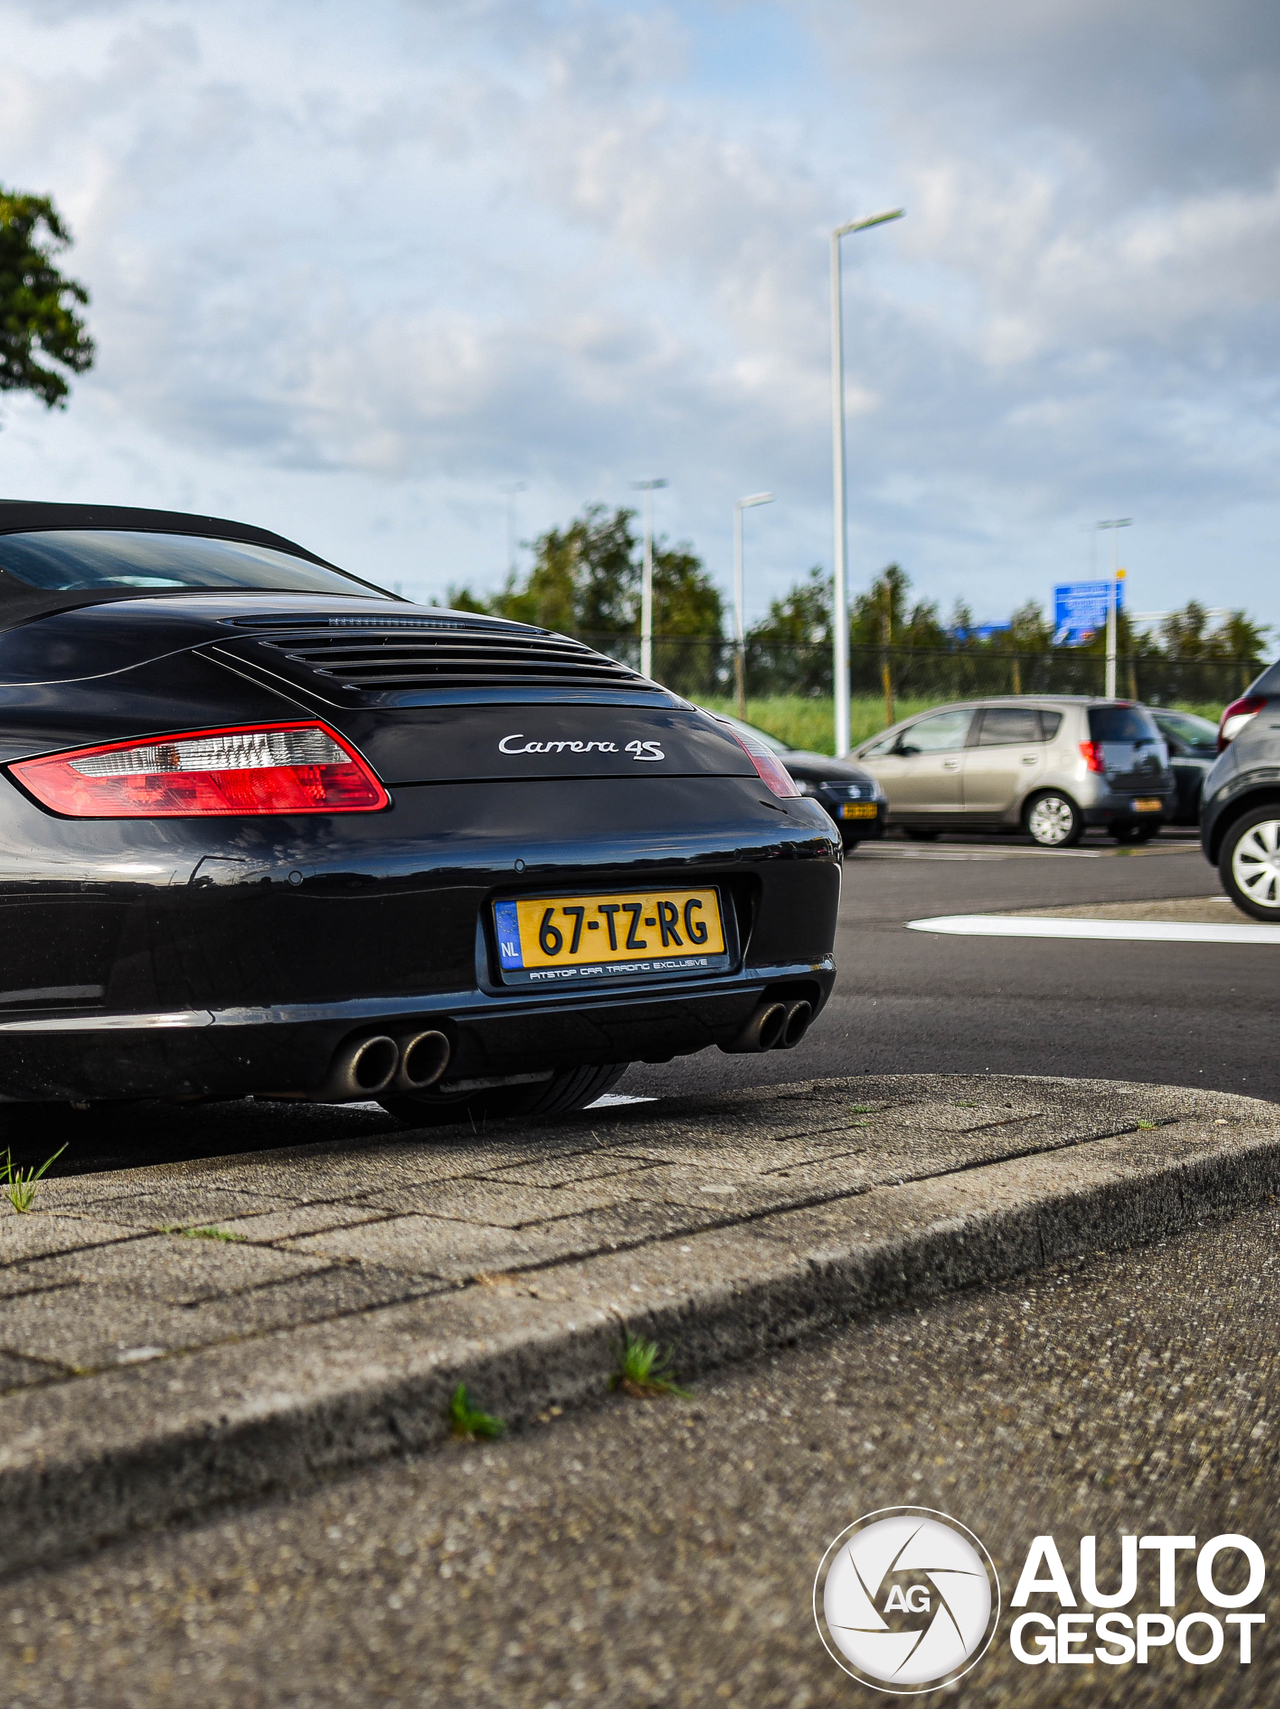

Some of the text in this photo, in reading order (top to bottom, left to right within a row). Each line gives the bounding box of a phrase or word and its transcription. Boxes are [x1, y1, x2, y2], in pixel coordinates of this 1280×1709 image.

[498, 734, 665, 761] Carrera 4S
[539, 899, 708, 956] 67-TZ-RG
[501, 942, 519, 957] NL
[529, 958, 708, 980] PITSTOP CAR TRADING EXCLUSIVE
